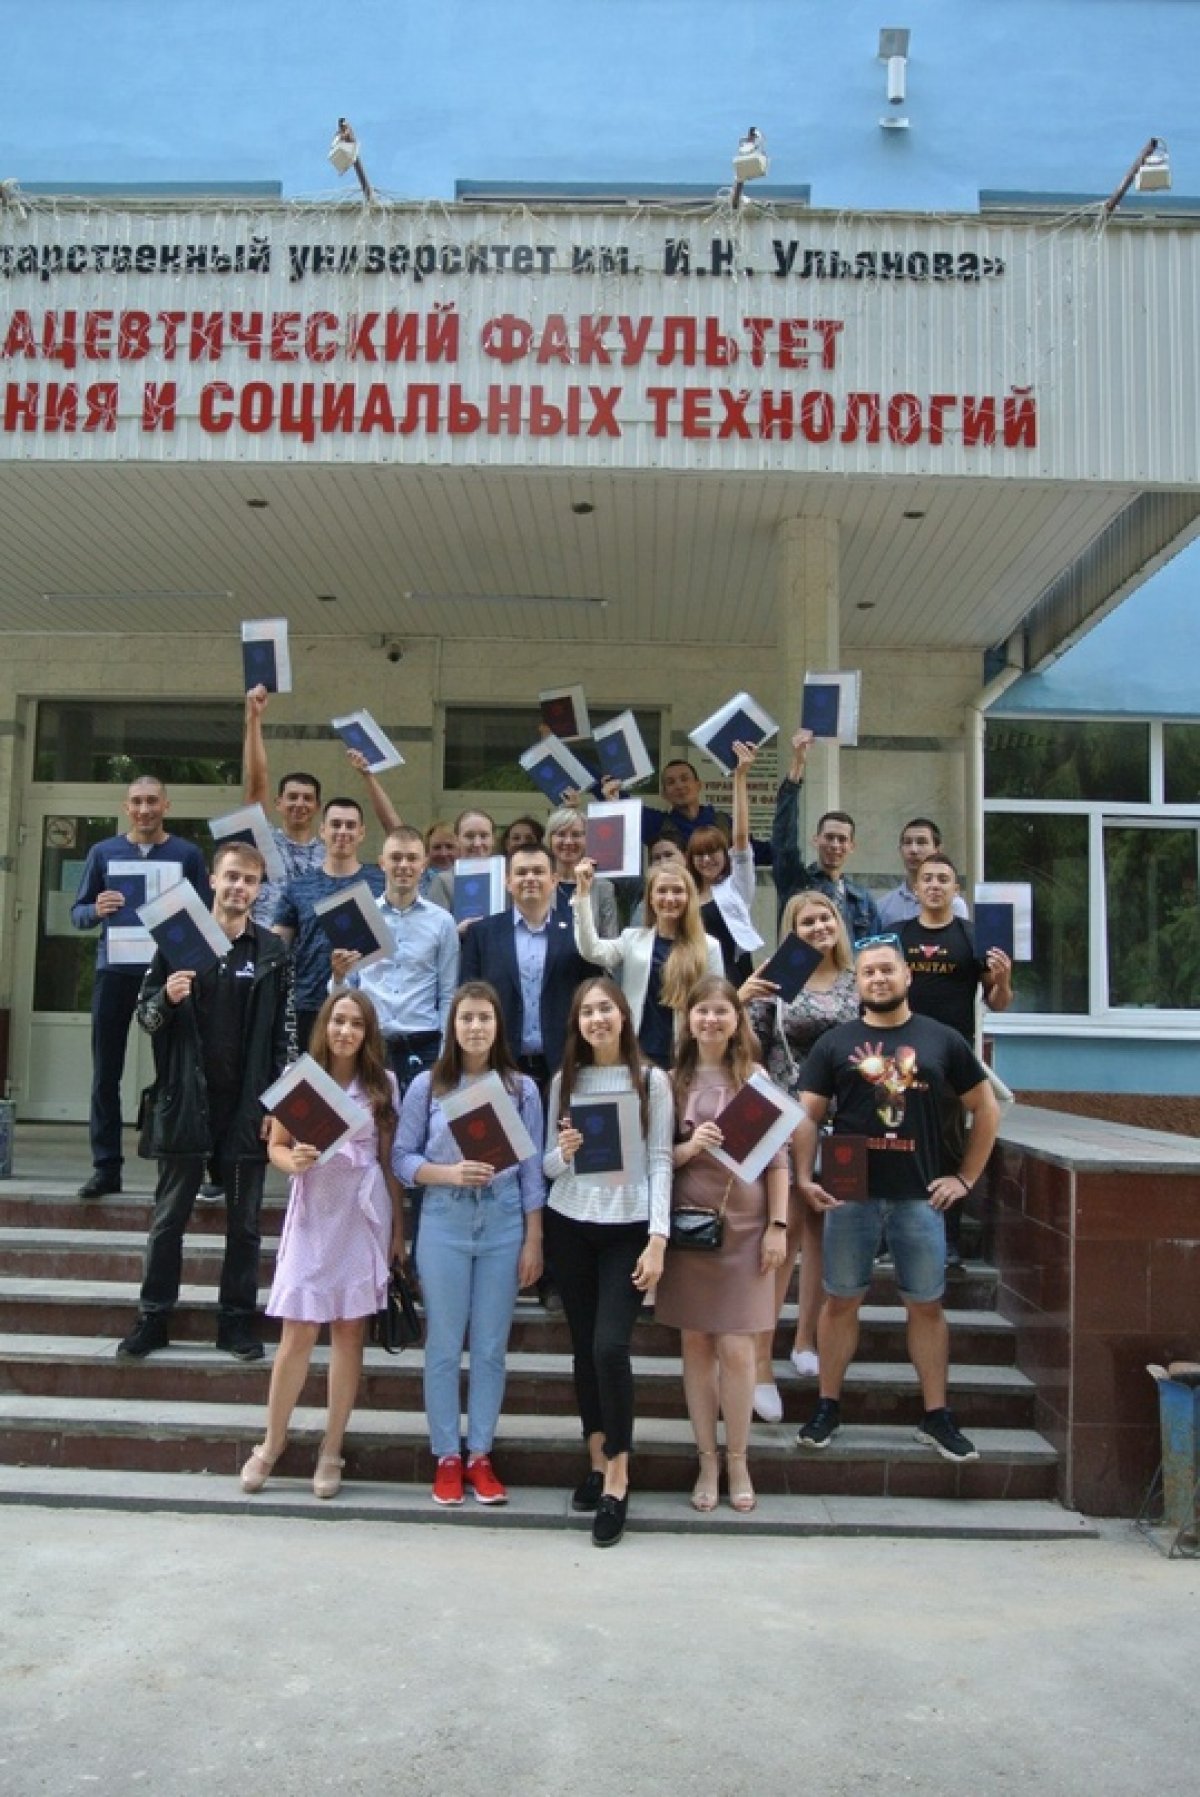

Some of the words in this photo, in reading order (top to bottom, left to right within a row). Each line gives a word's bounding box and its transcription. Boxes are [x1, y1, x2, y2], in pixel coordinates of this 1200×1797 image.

[289, 244, 557, 283] университет
[772, 239, 1006, 283] Ульянова»
[2, 302, 460, 369] АЦЕВТИЧЕСКИЙ
[481, 313, 845, 371] ФАКУЛЬТЕТ
[3, 382, 119, 433] НИЯ
[142, 382, 177, 433] И
[200, 380, 623, 444] СОЦИАЛЬНЫХ
[646, 385, 1037, 449] ТЕХНОЛОГИЙ
